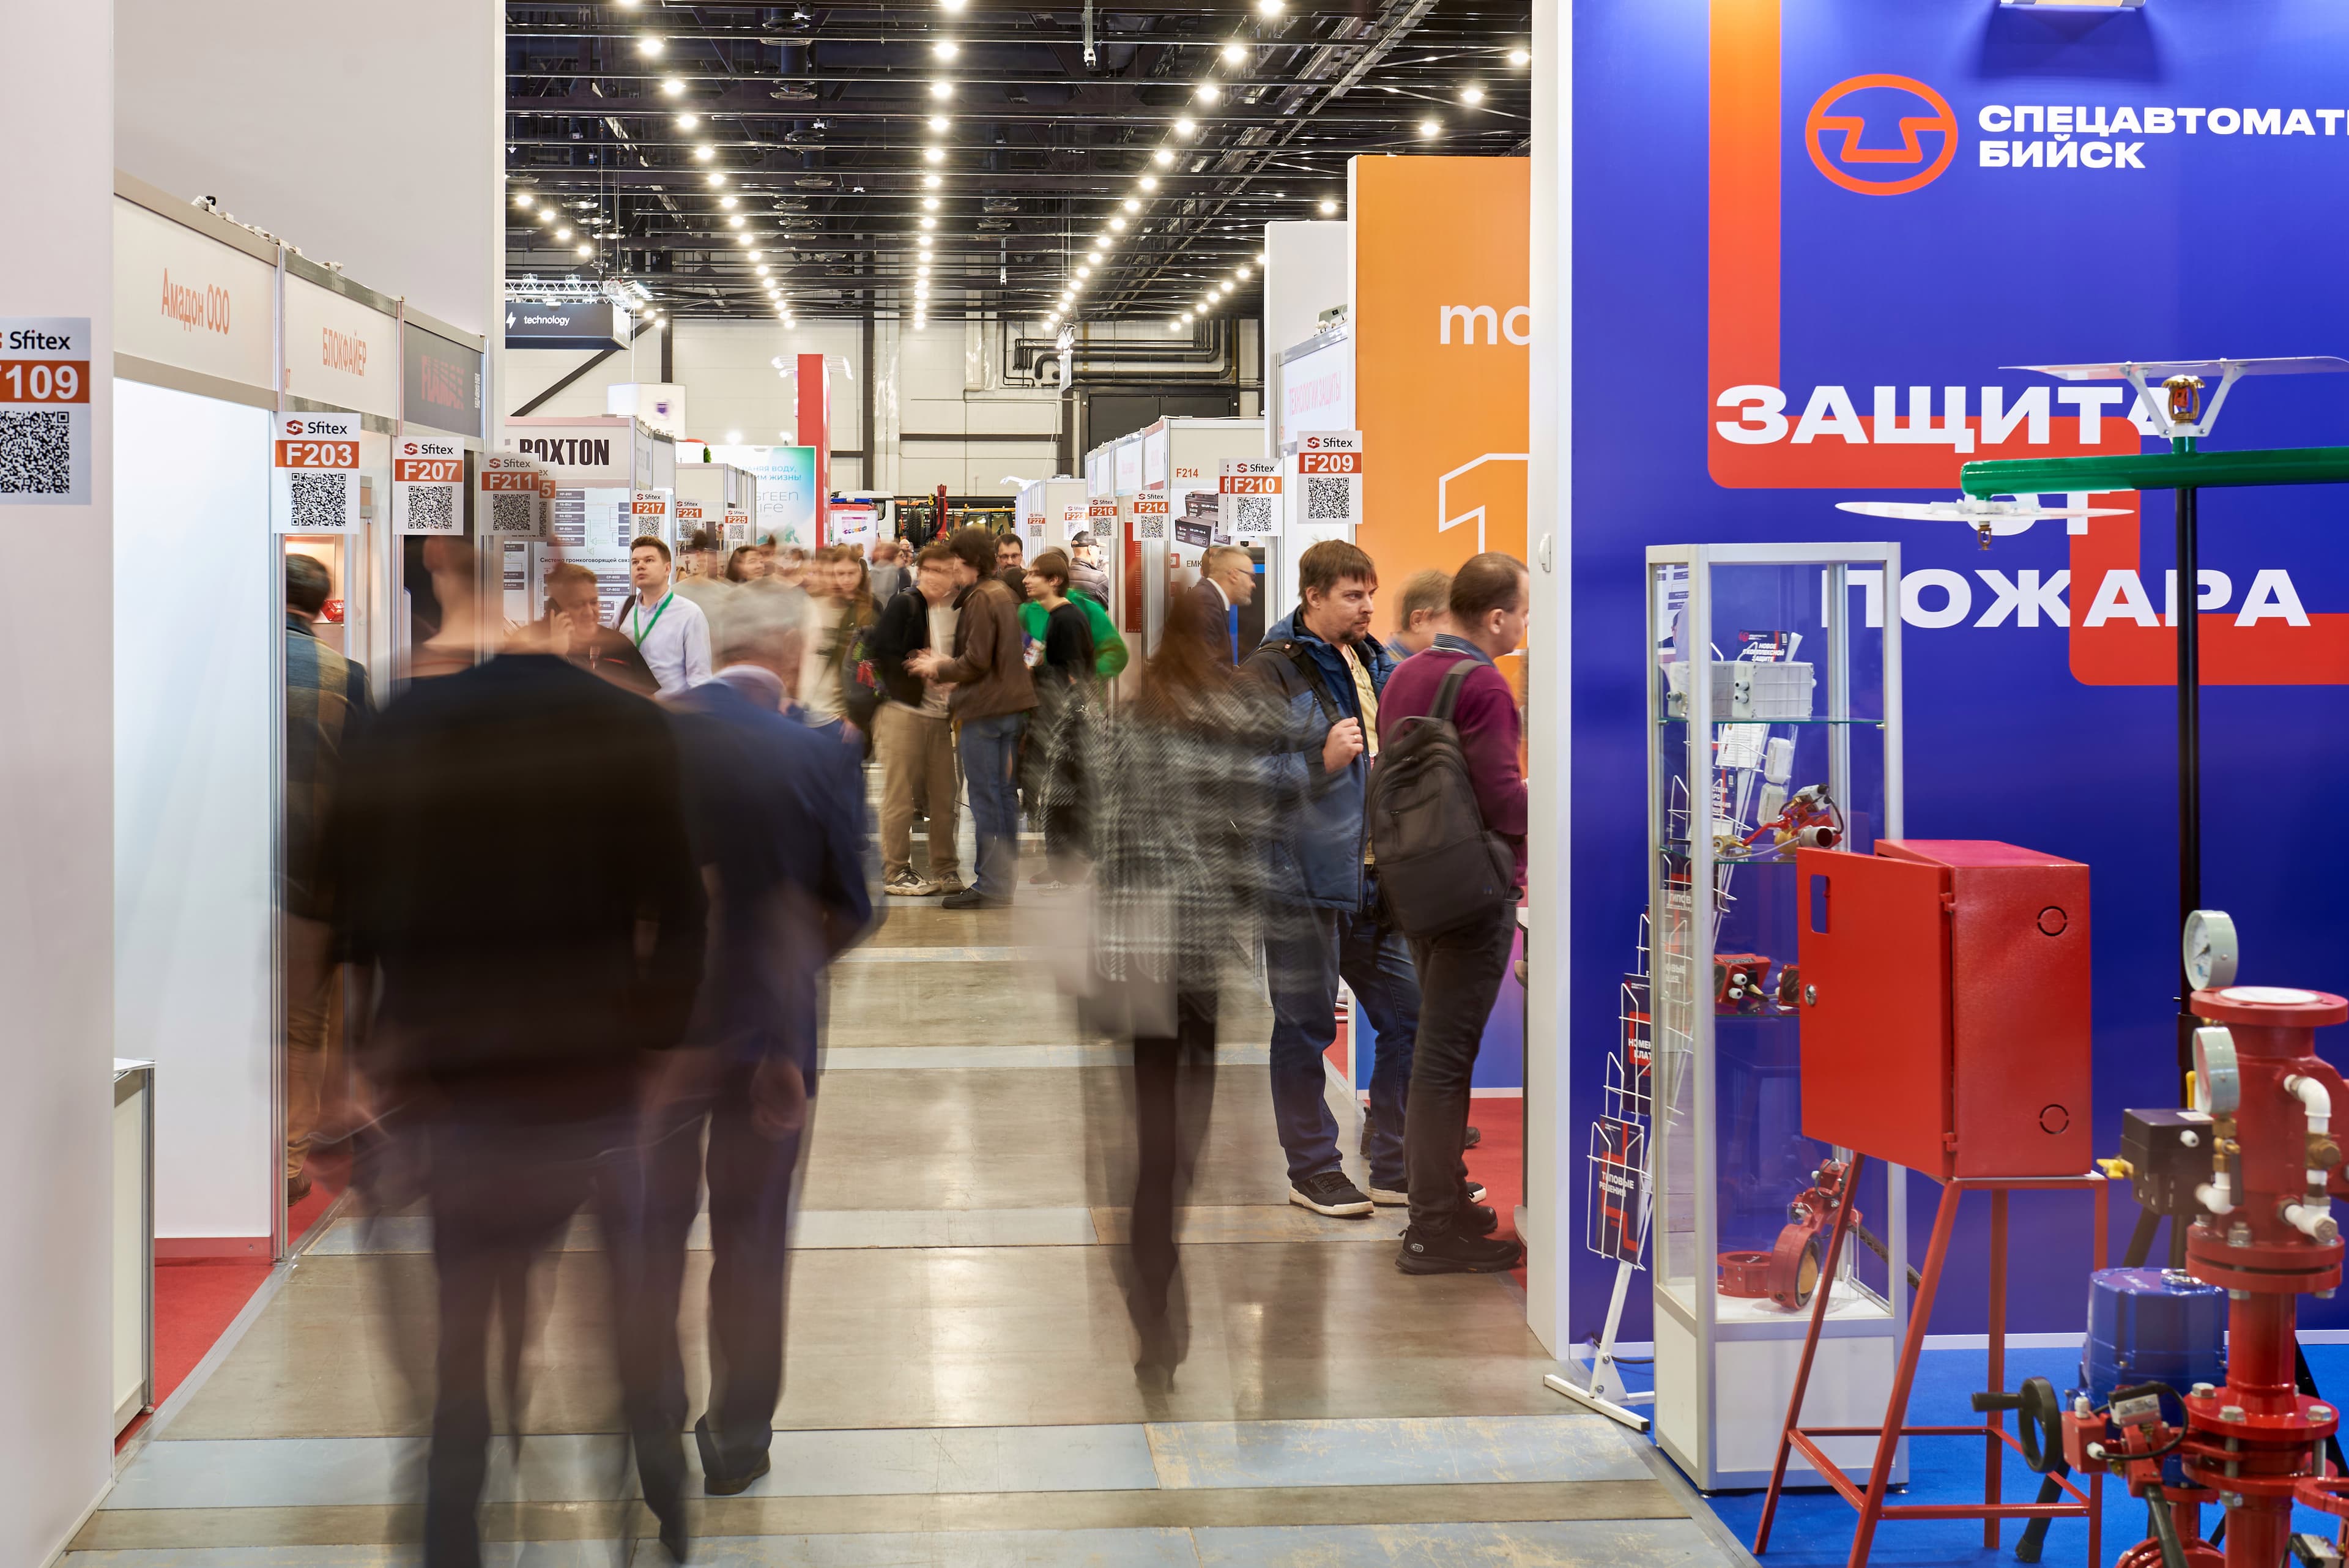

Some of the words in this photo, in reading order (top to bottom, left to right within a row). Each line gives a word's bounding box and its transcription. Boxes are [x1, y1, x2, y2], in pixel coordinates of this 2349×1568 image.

[1979, 105, 2349, 137] СПЕЦАВТОМАТ
[1979, 133, 2146, 168] БИЙСК
[161, 267, 204, 332] Амадон
[207, 283, 230, 335] ООО
[524, 315, 570, 326] technology
[10, 329, 71, 350] Sfitex
[322, 327, 366, 377] БЛОКФАЙЕР
[0, 365, 78, 399] 109
[1289, 378, 1318, 417] ТЕХНОЛОГИИ
[1318, 371, 1341, 411] ЗАЩИТЫ
[308, 421, 347, 434] Sfitex
[421, 442, 453, 455] Sfitex
[1323, 437, 1353, 447] Sfitex
[286, 443, 353, 466] F203
[520, 439, 609, 465] BOXTON
[404, 461, 458, 480] F207
[503, 458, 530, 468] Sfitex
[1250, 464, 1275, 473] Sfitex
[1304, 455, 1354, 472] F209
[1176, 469, 1198, 478] F214
[489, 474, 532, 489] F211
[1234, 478, 1275, 493] F210
[636, 503, 662, 513] F217
[677, 509, 699, 518] F221
[1091, 507, 1113, 516] F216
[1138, 503, 1166, 513] F214
[1821, 569, 2310, 628] ПОЖАРА
